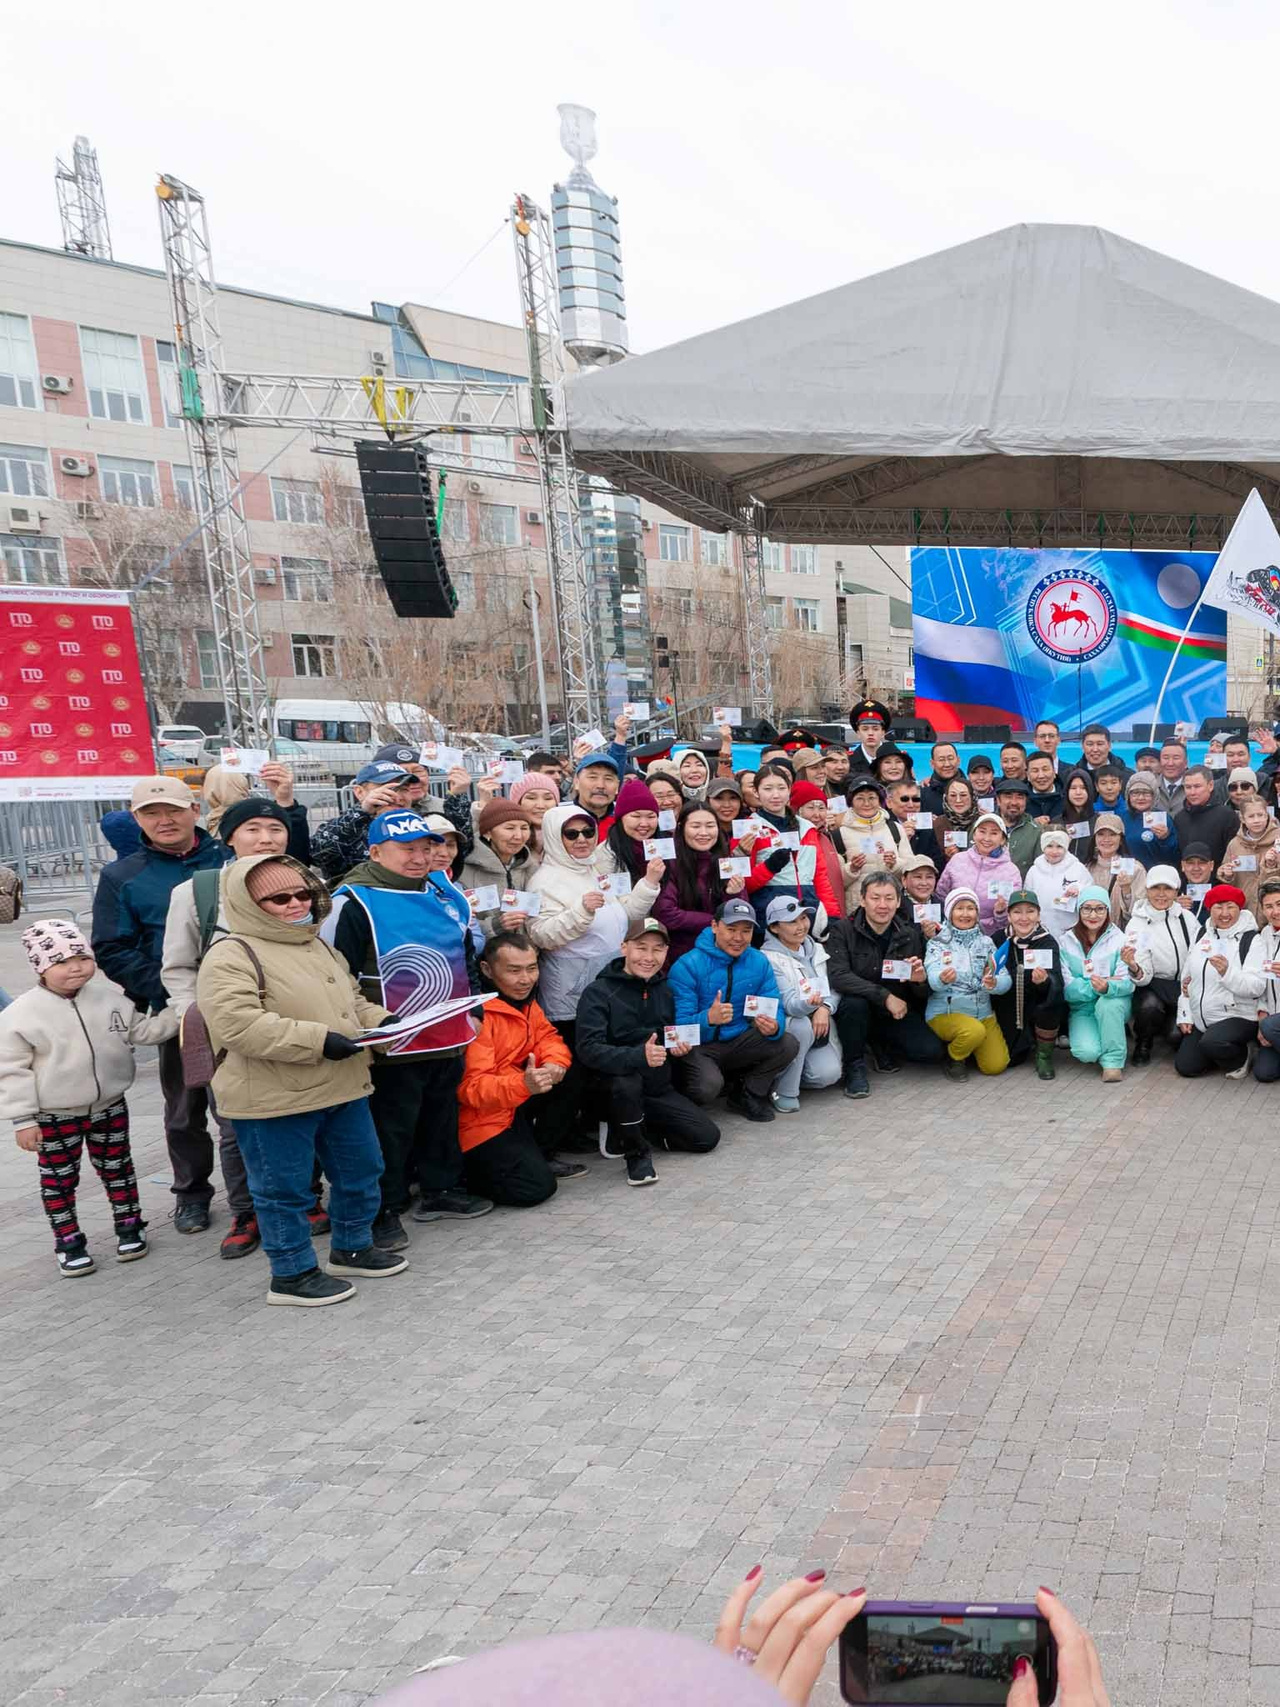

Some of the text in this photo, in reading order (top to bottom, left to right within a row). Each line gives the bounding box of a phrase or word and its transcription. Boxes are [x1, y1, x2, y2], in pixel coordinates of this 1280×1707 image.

[9, 612, 33, 627] ГТО
[91, 615, 114, 629] ГТО
[58, 641, 81, 655] ГТО
[20, 668, 43, 682] ГТО
[102, 670, 123, 684] ГТО
[68, 696, 91, 710] ГТО
[30, 723, 52, 737] ГТО
[111, 723, 132, 737] ГТО
[77, 750, 99, 764] ГТО
